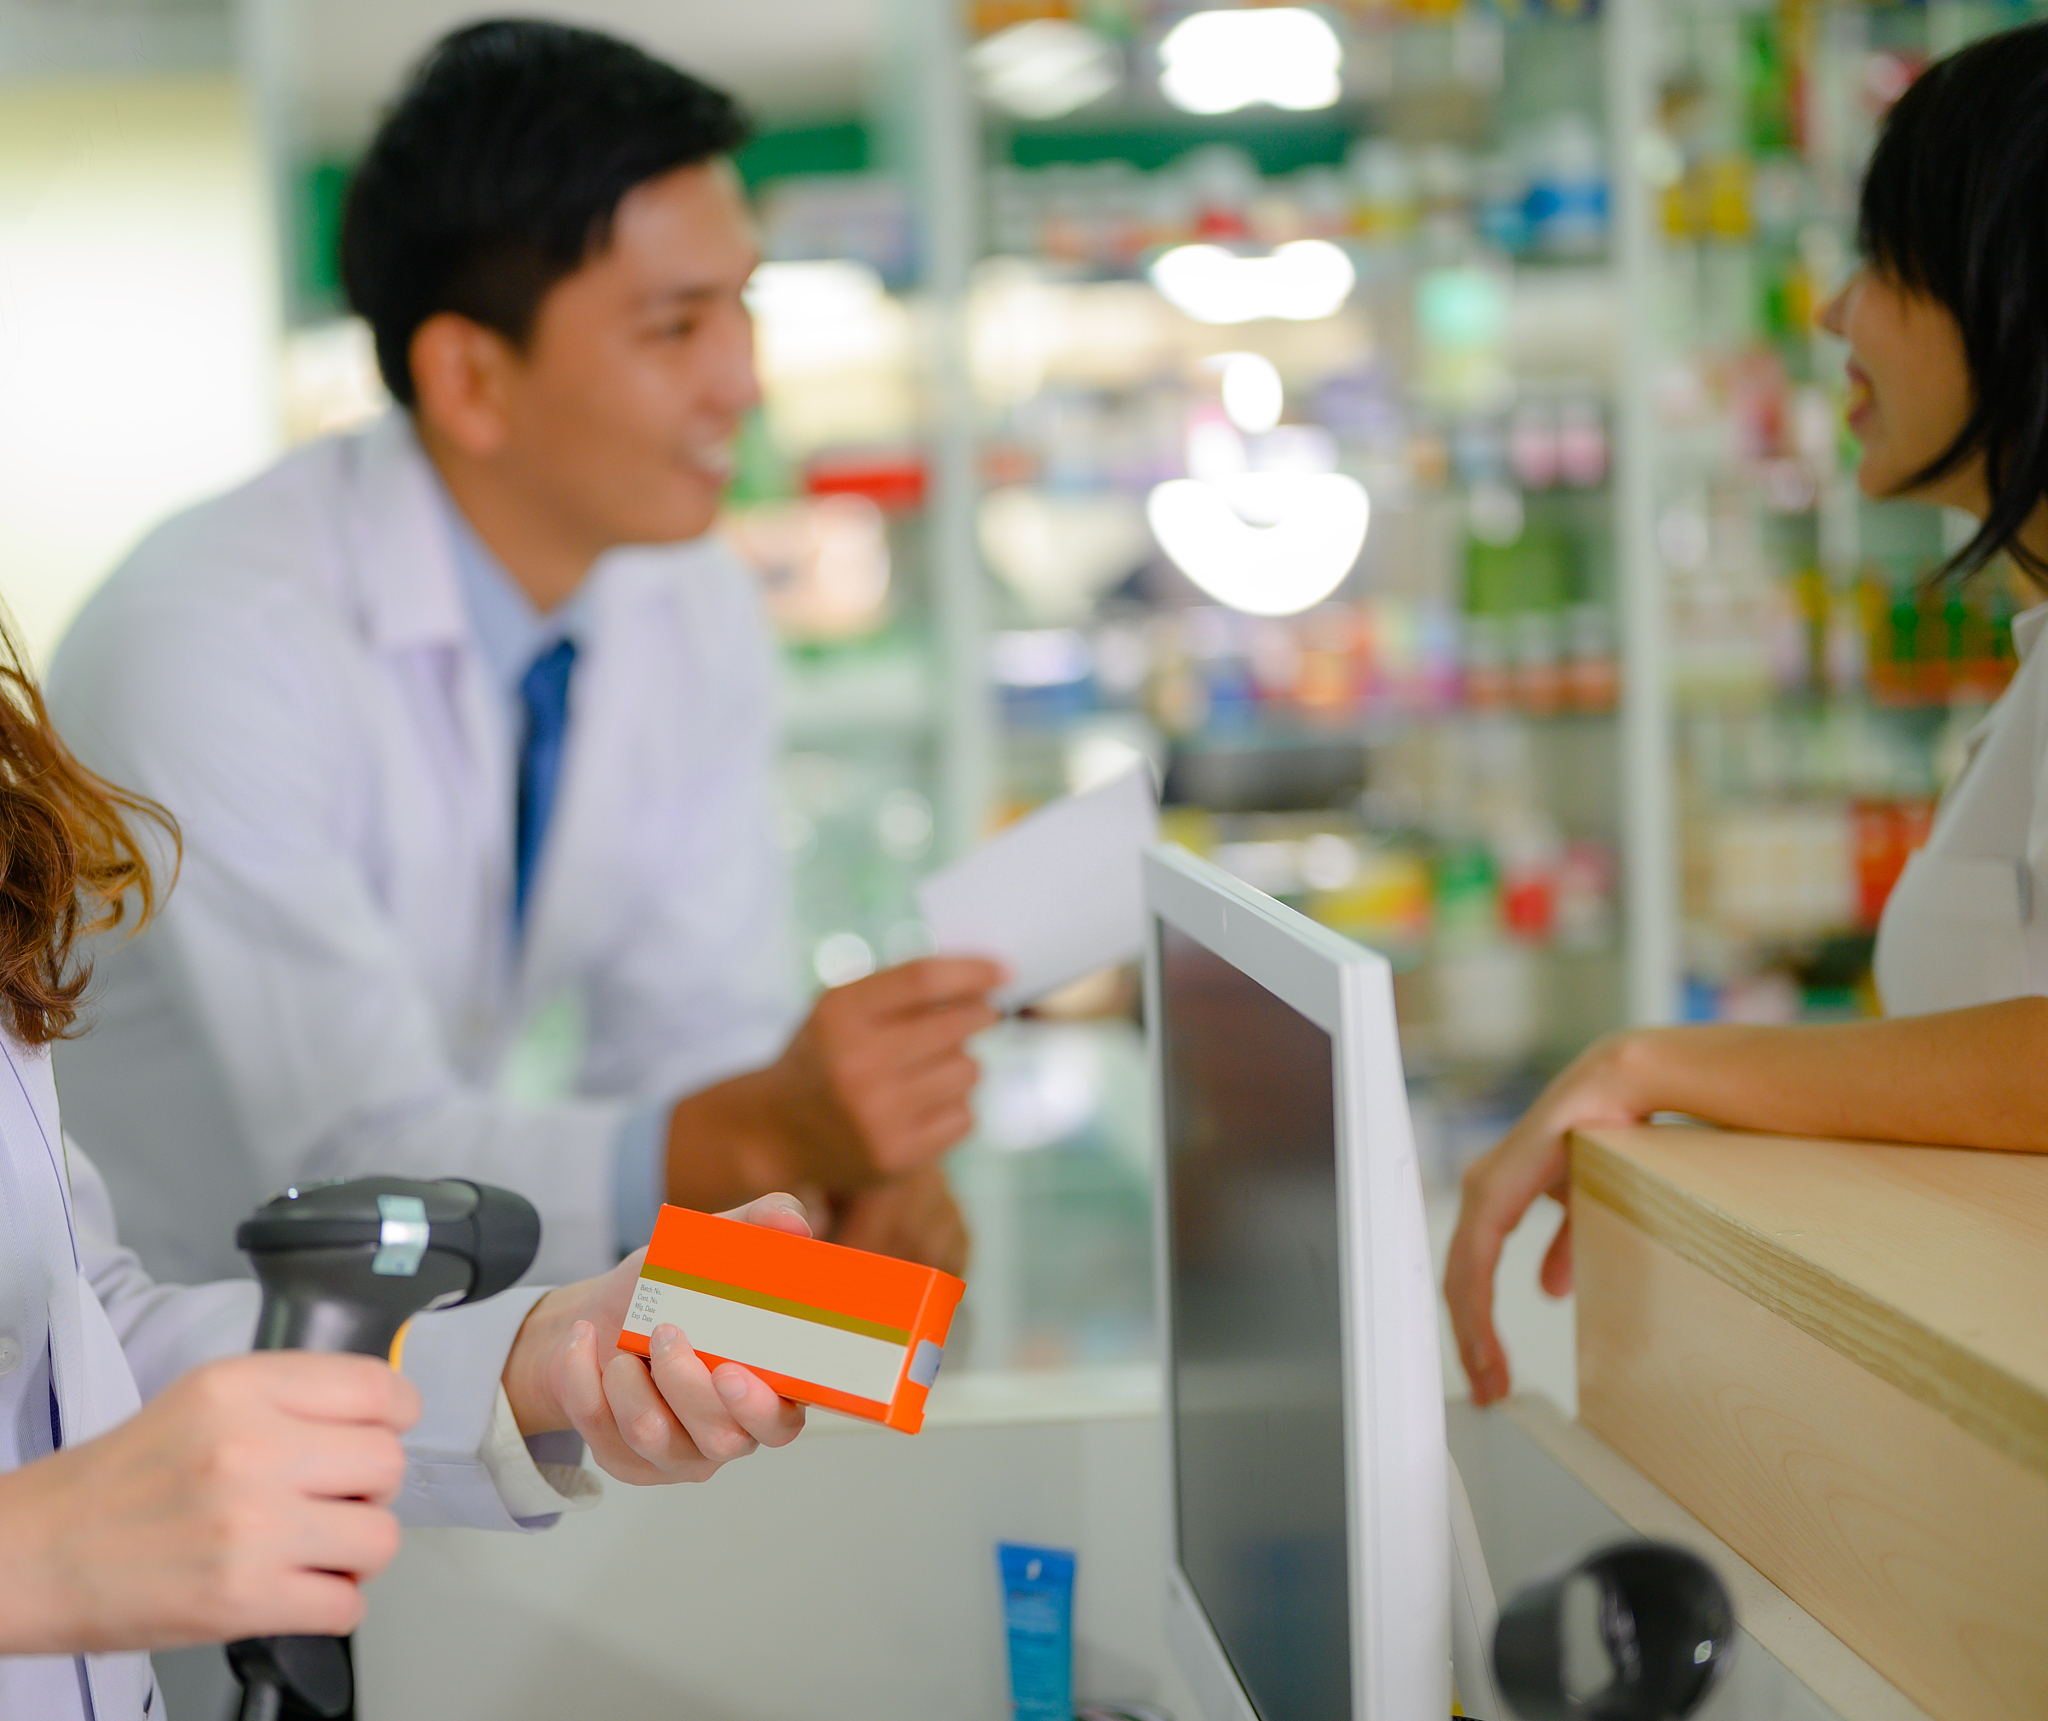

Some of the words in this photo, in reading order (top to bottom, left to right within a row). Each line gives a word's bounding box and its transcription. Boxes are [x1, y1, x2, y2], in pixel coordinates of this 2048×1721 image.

[640, 1284, 653, 1293] Batch
[644, 1305, 656, 1313] Date
[642, 1314, 653, 1323] Date
